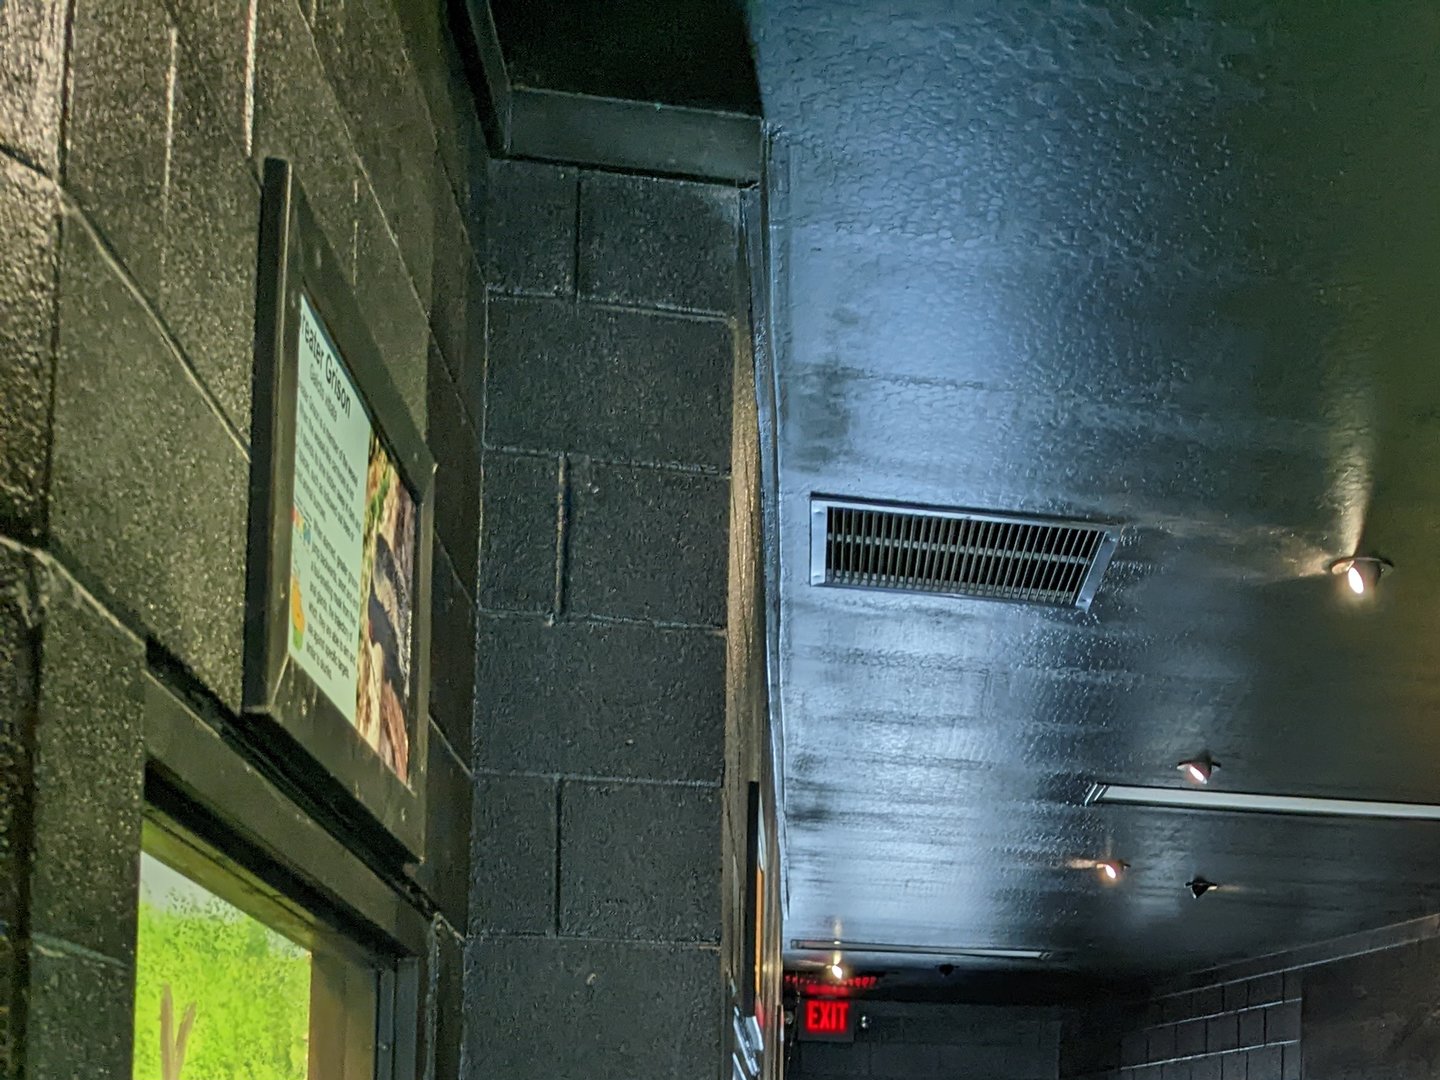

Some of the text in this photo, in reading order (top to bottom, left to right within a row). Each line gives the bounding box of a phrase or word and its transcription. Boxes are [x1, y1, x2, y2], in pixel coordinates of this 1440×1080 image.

[301, 315, 324, 369] reater
[325, 353, 351, 419] Grison
[806, 1000, 849, 1032] EXIT
